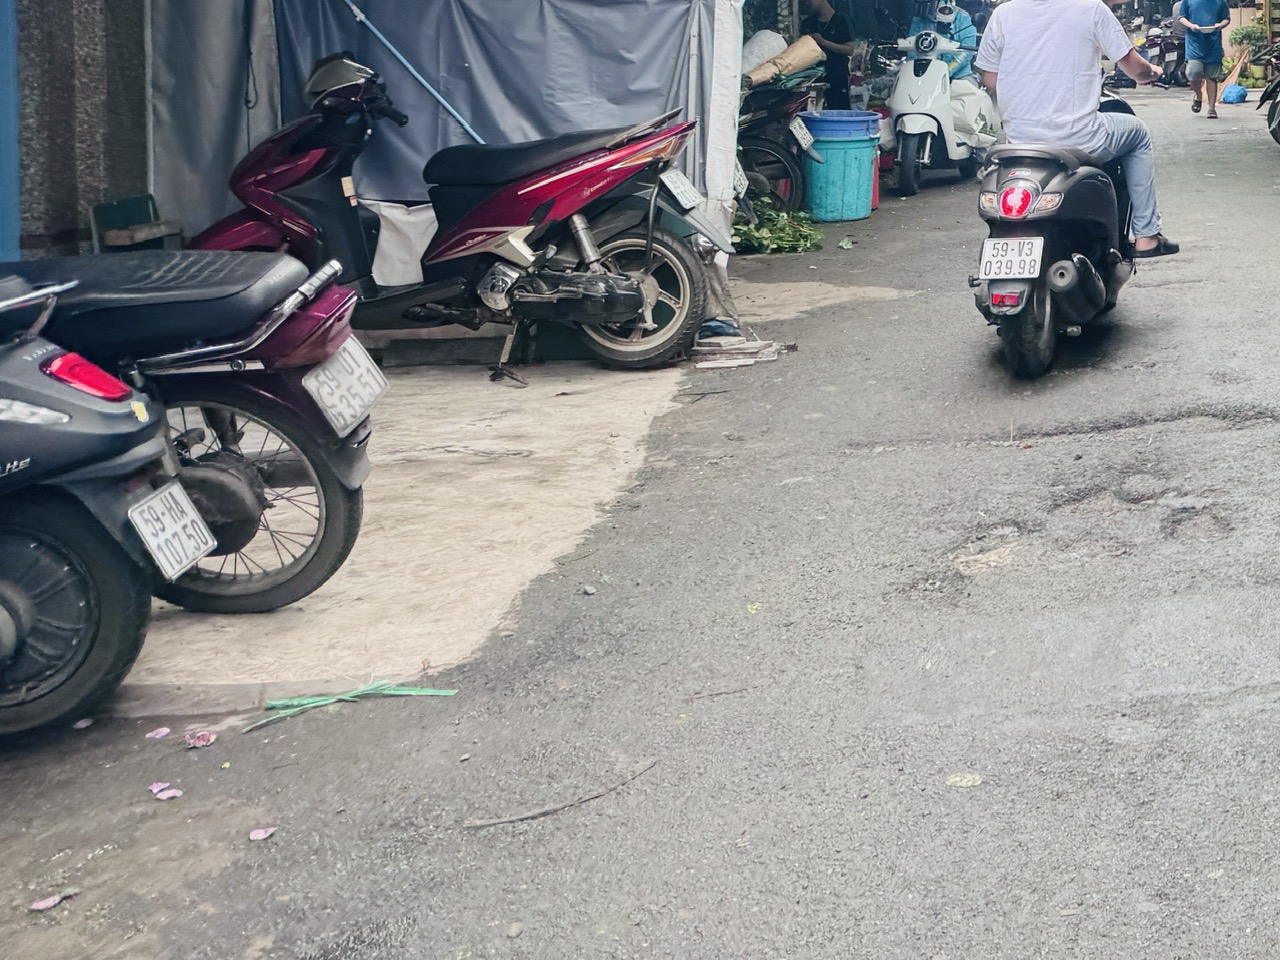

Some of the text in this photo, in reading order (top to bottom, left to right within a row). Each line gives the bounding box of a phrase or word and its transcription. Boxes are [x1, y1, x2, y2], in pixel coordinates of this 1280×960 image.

[991, 241, 1034, 258] 59-V3
[983, 259, 1037, 277] 039.98
[138, 490, 188, 538] 59-HA
[156, 518, 209, 571] 107.50
